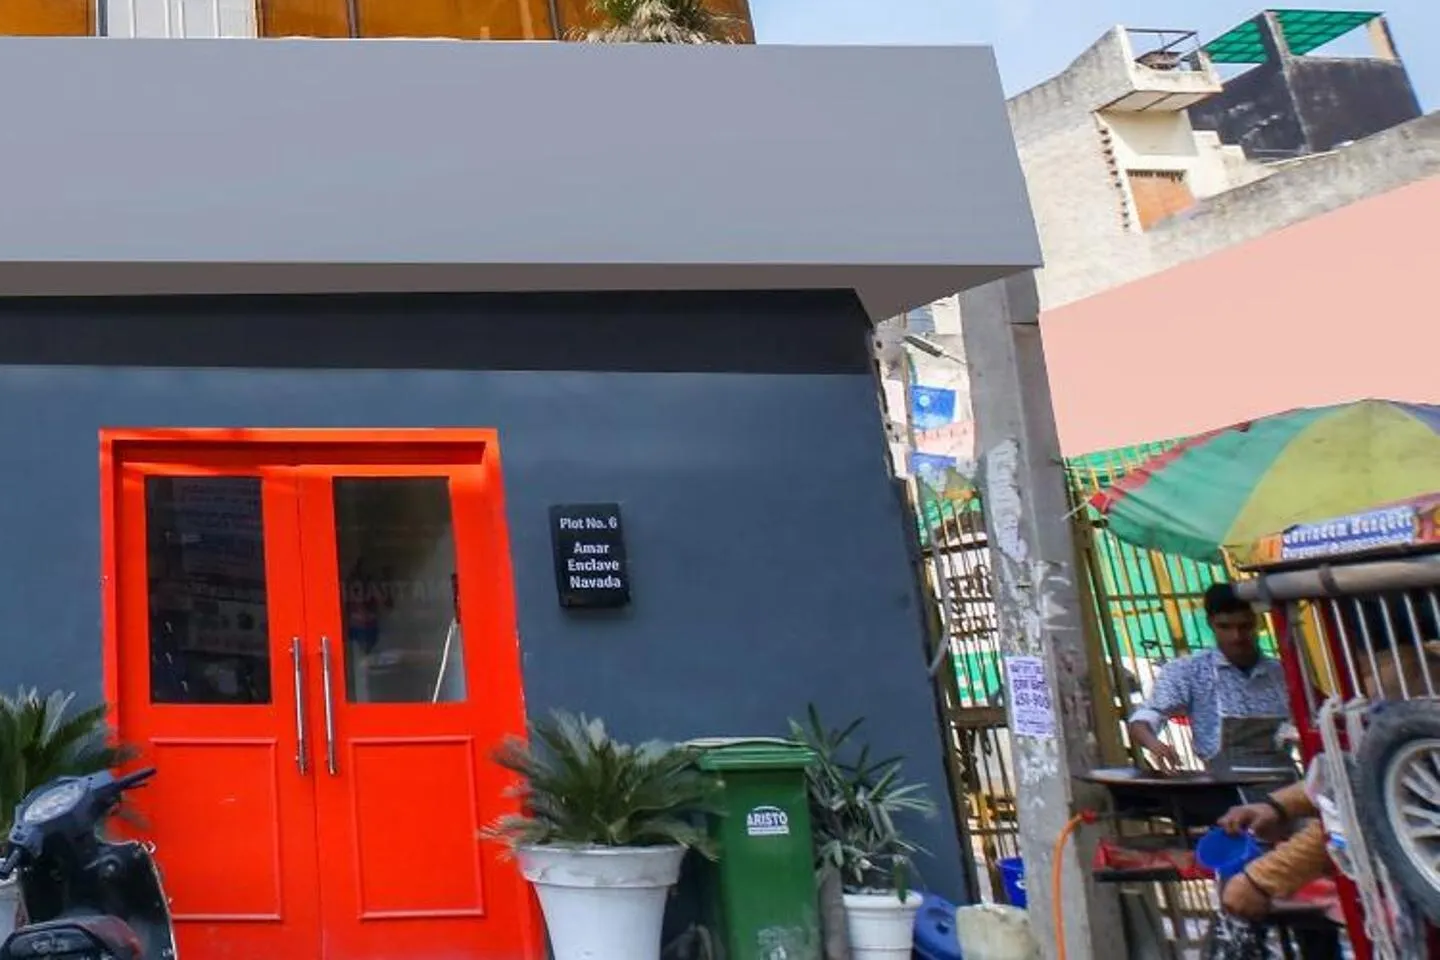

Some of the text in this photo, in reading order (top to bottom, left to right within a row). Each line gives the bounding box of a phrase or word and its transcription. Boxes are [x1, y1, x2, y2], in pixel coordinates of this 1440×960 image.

[560, 517, 618, 529] Plot No. 6
[573, 542, 610, 554] Amar
[567, 559, 620, 571] Enclave
[569, 575, 622, 589] Navada
[747, 811, 788, 826] ARISTO
